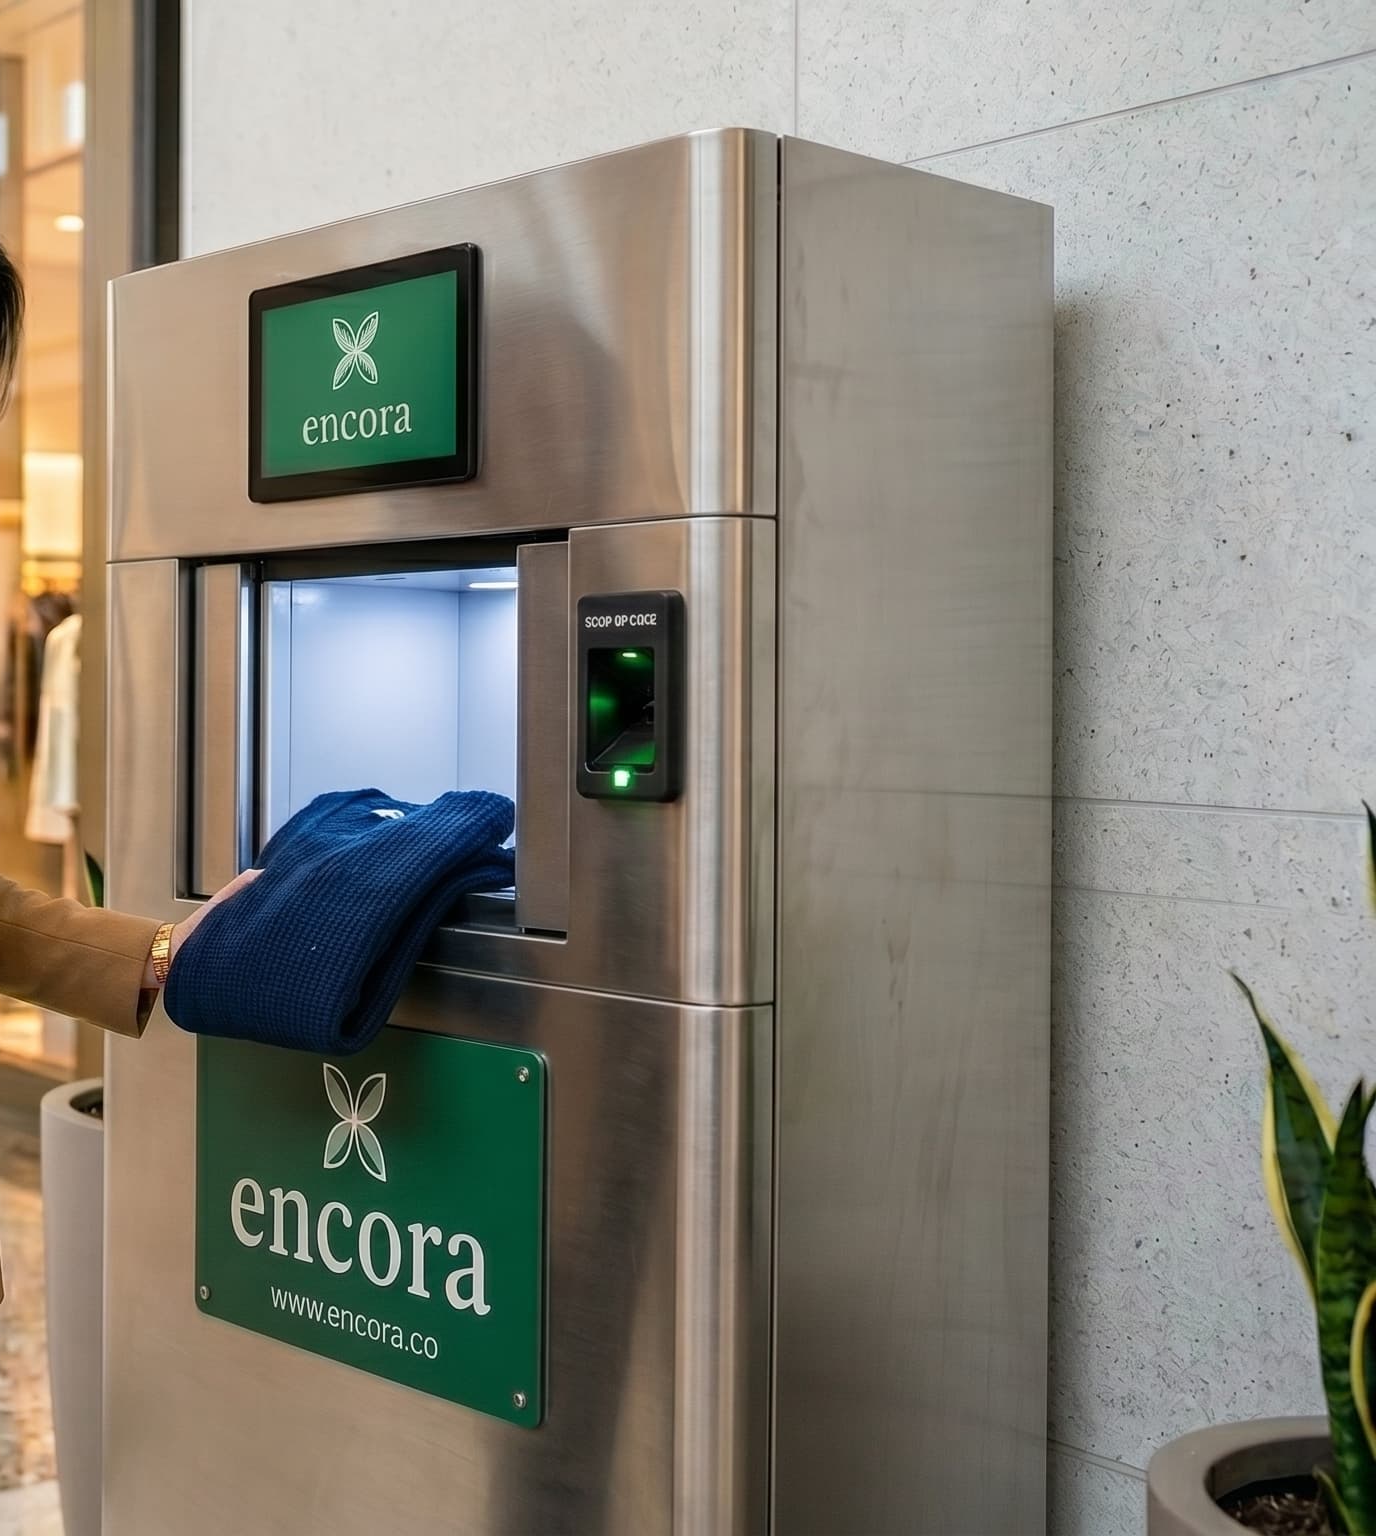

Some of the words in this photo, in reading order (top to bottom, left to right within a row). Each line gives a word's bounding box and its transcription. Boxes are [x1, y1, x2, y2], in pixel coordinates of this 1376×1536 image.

[302, 402, 412, 446] encora
[230, 1177, 492, 1316] encora
[270, 1285, 439, 1360] www.encora.co
